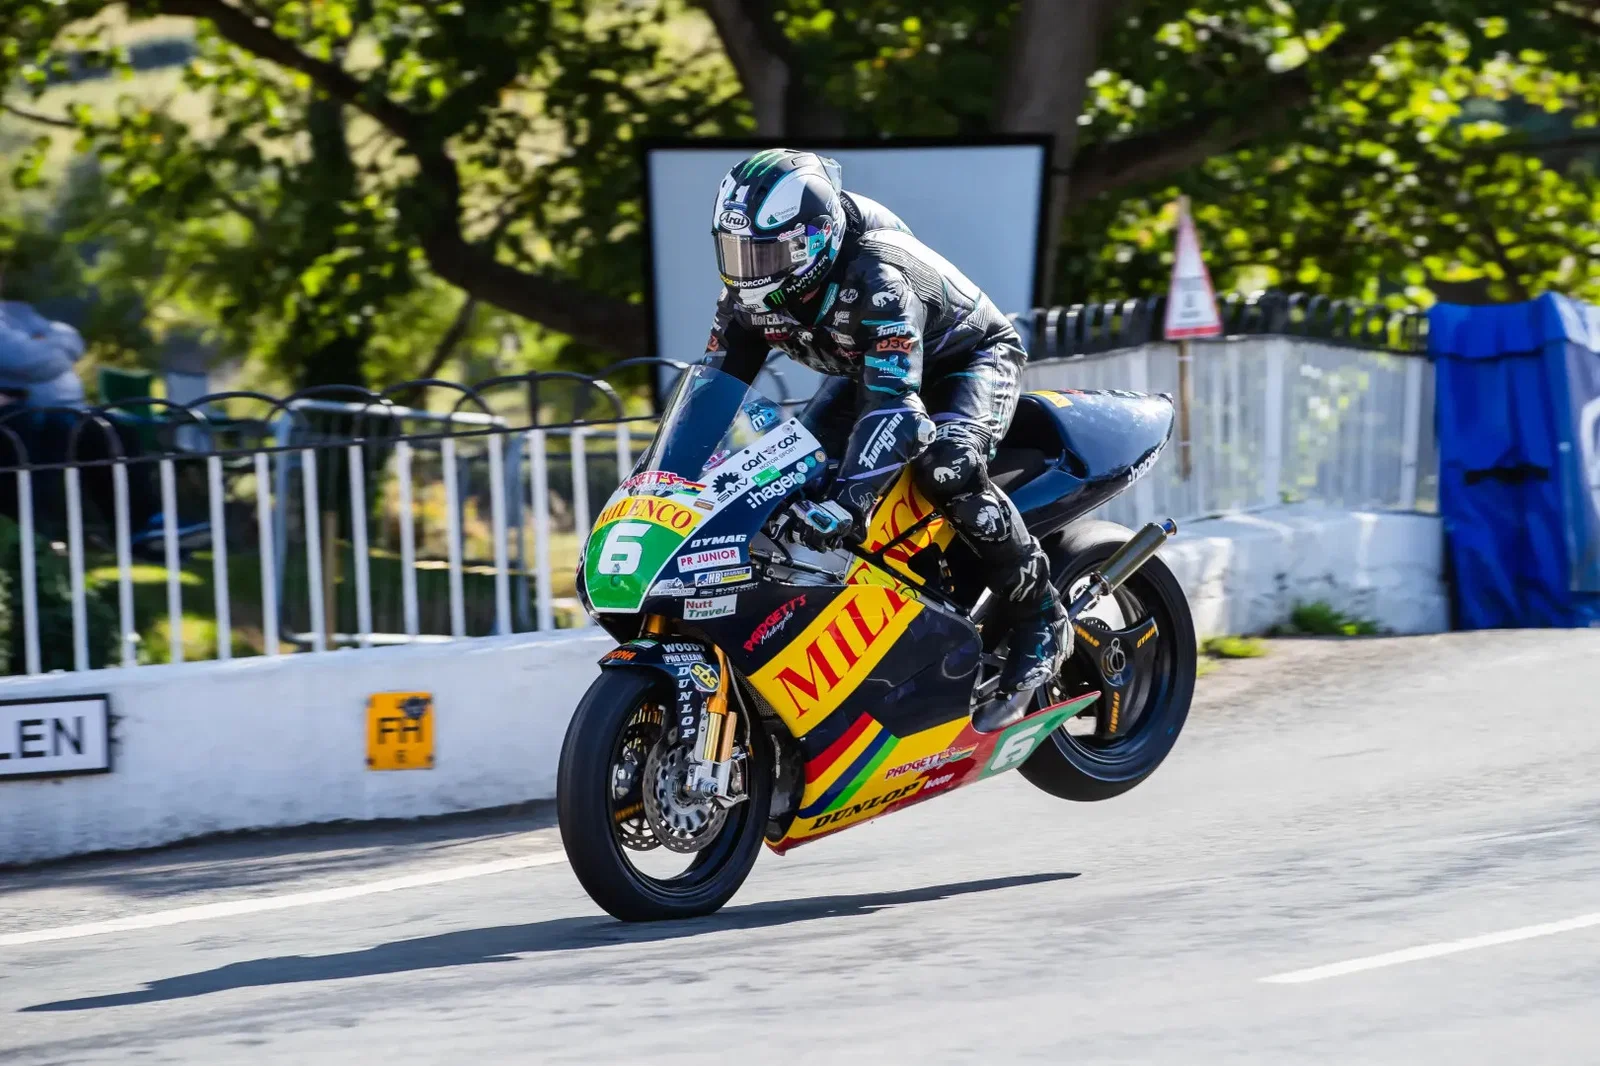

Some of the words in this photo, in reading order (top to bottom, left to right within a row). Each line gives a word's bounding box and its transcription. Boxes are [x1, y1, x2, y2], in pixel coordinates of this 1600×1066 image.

[723, 211, 745, 226] Arai
[741, 451, 768, 472] carl
[777, 431, 802, 449] cox
[857, 412, 904, 470] Furygan
[717, 477, 749, 503] SMV
[598, 498, 693, 530] MILENCO
[597, 521, 653, 575] 6
[690, 534, 747, 548] DYMAG
[681, 556, 693, 567] PR
[697, 549, 737, 564] JUNIOR
[707, 570, 722, 585] HB
[685, 599, 713, 609] Nutt
[661, 642, 706, 653] WOODY
[665, 654, 681, 663] PRO
[677, 666, 697, 739] DUNLOP
[0, 715, 86, 760] EN
[376, 716, 424, 745] FH
[990, 722, 1045, 769] 6
[808, 780, 921, 831] DUNLOP
